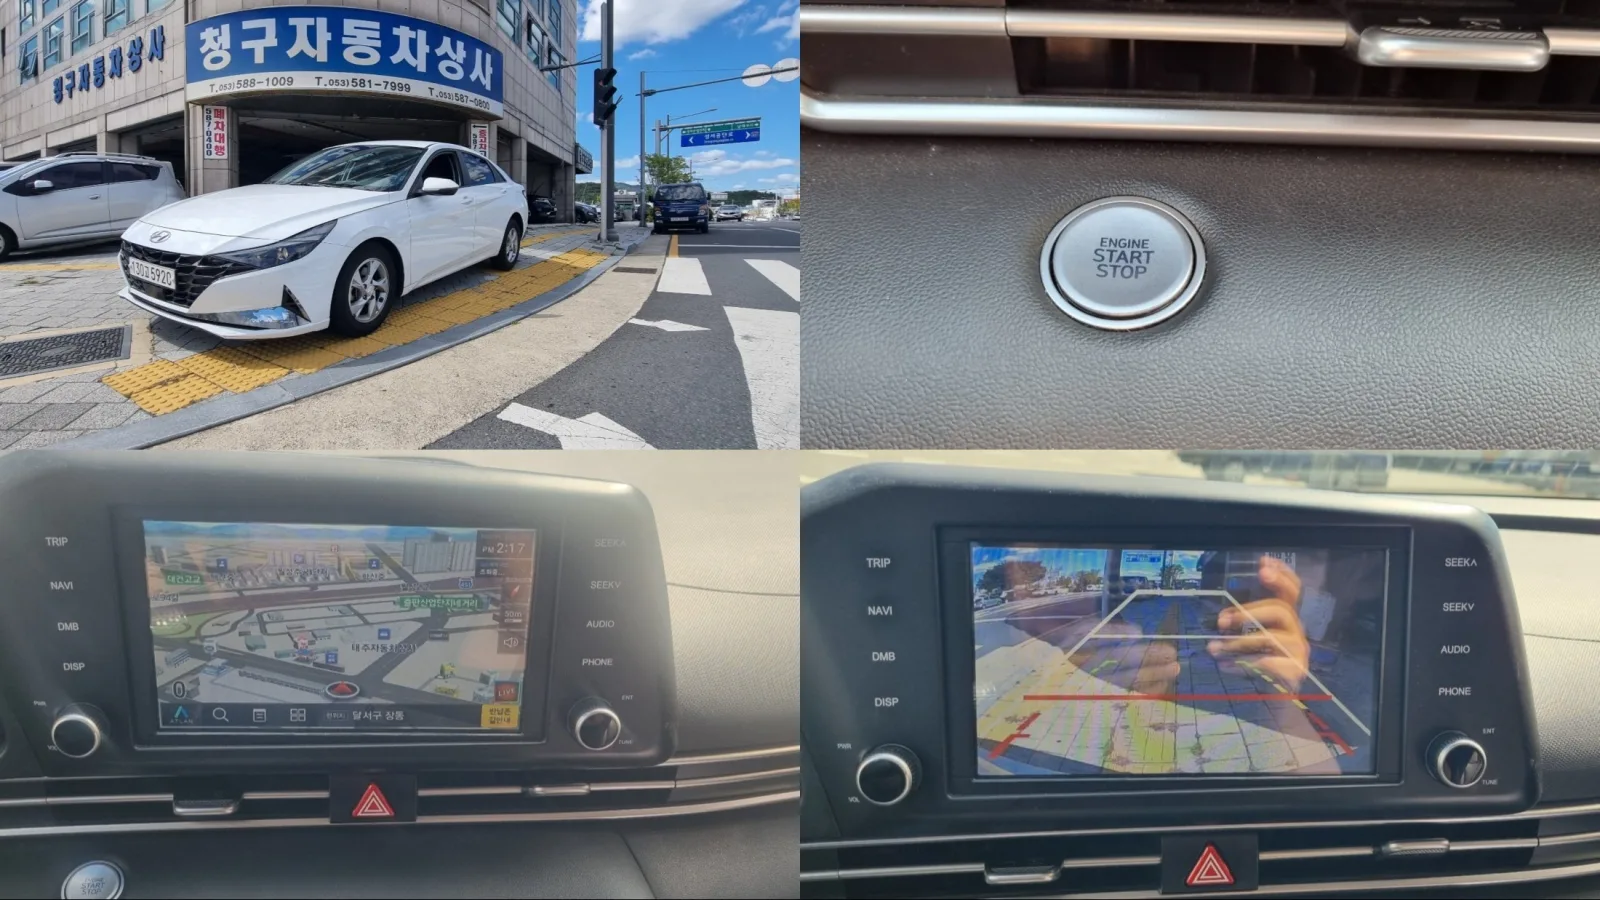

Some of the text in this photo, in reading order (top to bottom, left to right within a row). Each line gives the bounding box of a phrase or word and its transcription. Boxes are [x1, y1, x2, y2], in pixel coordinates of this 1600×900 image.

[200, 17, 493, 91] 청구자동차상사
[53, 25, 165, 104] 청구자동차상사
[213, 108, 225, 156] 폐차대행
[1100, 237, 1149, 249] ENGINE
[1092, 248, 1155, 264] START
[1096, 264, 1147, 279] STOP
[45, 536, 68, 547] TRIP
[496, 543, 526, 554] 2:17
[866, 558, 891, 568] TRIP
[50, 581, 73, 590] NAVI
[403, 598, 478, 608] 출판산업단지네거리
[504, 610, 522, 618] 50m
[868, 606, 893, 616] NAVI
[57, 622, 79, 631] DMB
[586, 619, 615, 629] AUDIO
[1440, 645, 1470, 654] AUDIO
[582, 657, 613, 666] PHONE
[872, 652, 896, 662] DMB
[63, 662, 85, 671] DISP
[173, 681, 186, 699] 0
[498, 688, 516, 697] LIVE
[1438, 687, 1471, 696] PHONE
[874, 697, 899, 707] DISP
[352, 711, 405, 721] 달서구 장동
